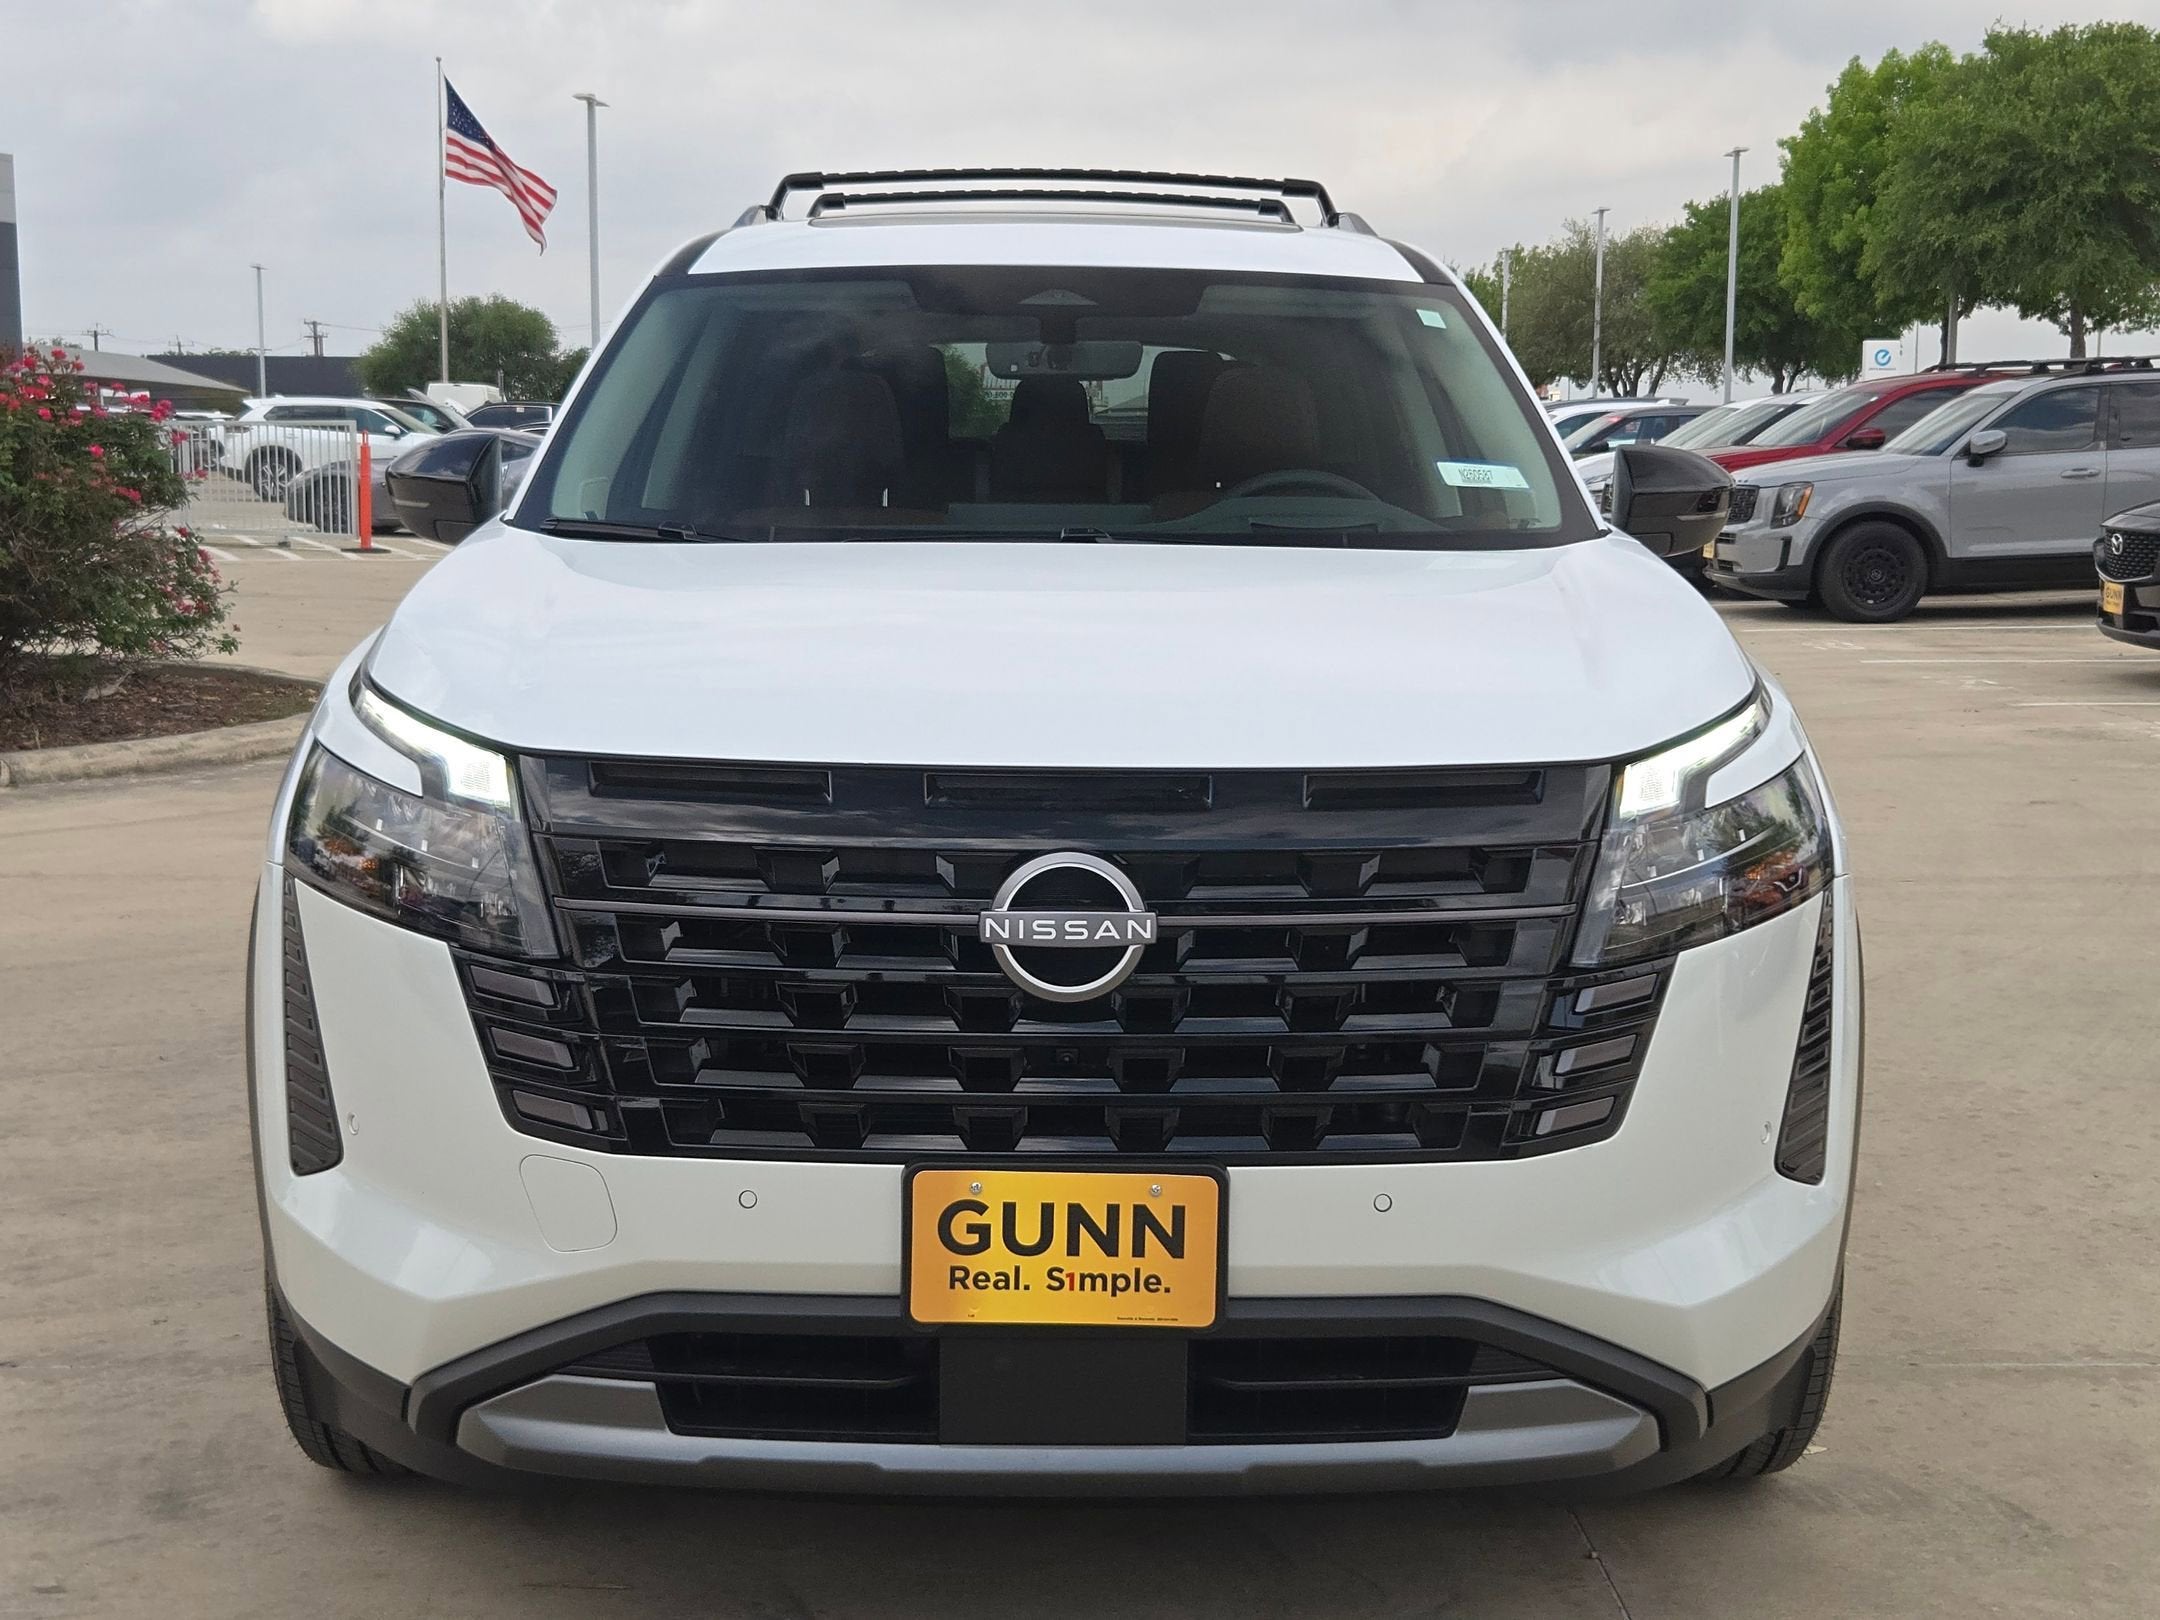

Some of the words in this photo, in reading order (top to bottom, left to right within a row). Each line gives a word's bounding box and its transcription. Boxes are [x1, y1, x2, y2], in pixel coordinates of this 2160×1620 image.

[985, 918, 1151, 940] NISSAN
[937, 1198, 1186, 1260] GUNN
[949, 1264, 1030, 1292] Real.
